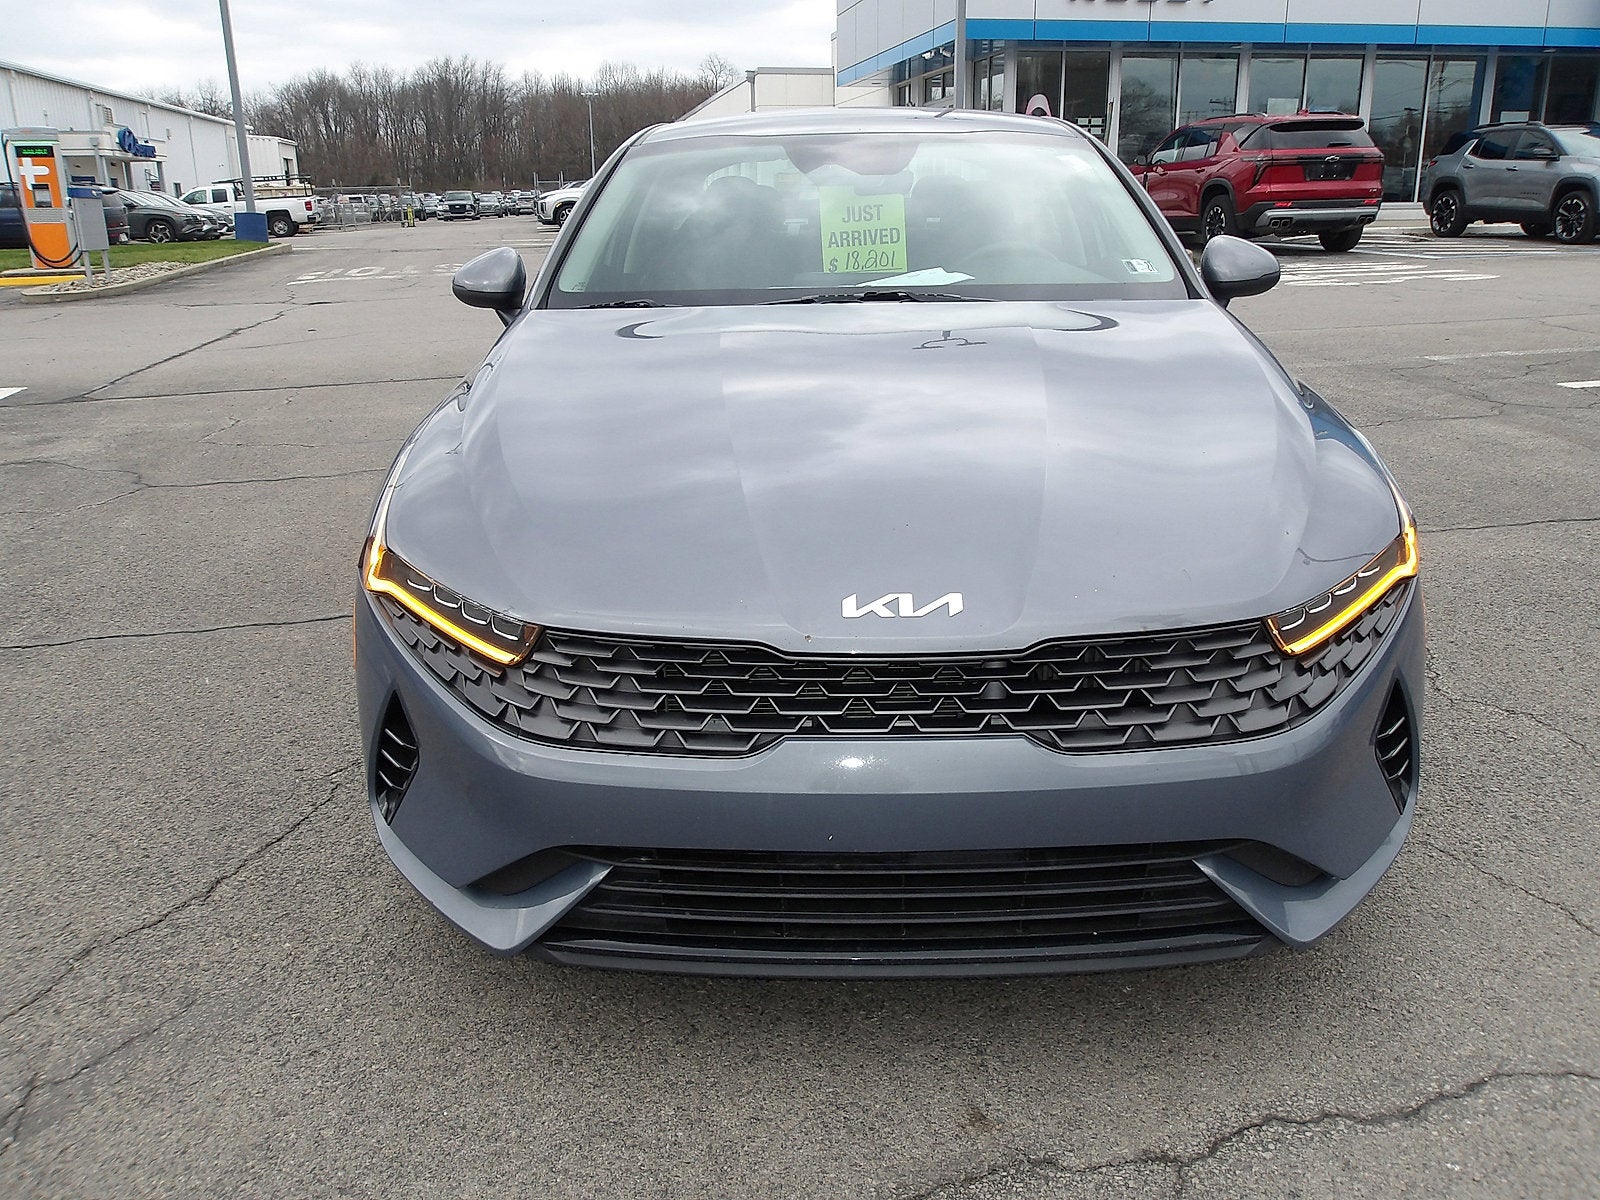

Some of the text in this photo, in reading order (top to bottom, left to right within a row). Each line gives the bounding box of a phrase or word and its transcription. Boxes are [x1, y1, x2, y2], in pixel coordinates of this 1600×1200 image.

[842, 204, 883, 223] JUST
[827, 227, 900, 248] ARRIVED
[845, 249, 895, 271] 18,201
[841, 592, 964, 619] KIA
